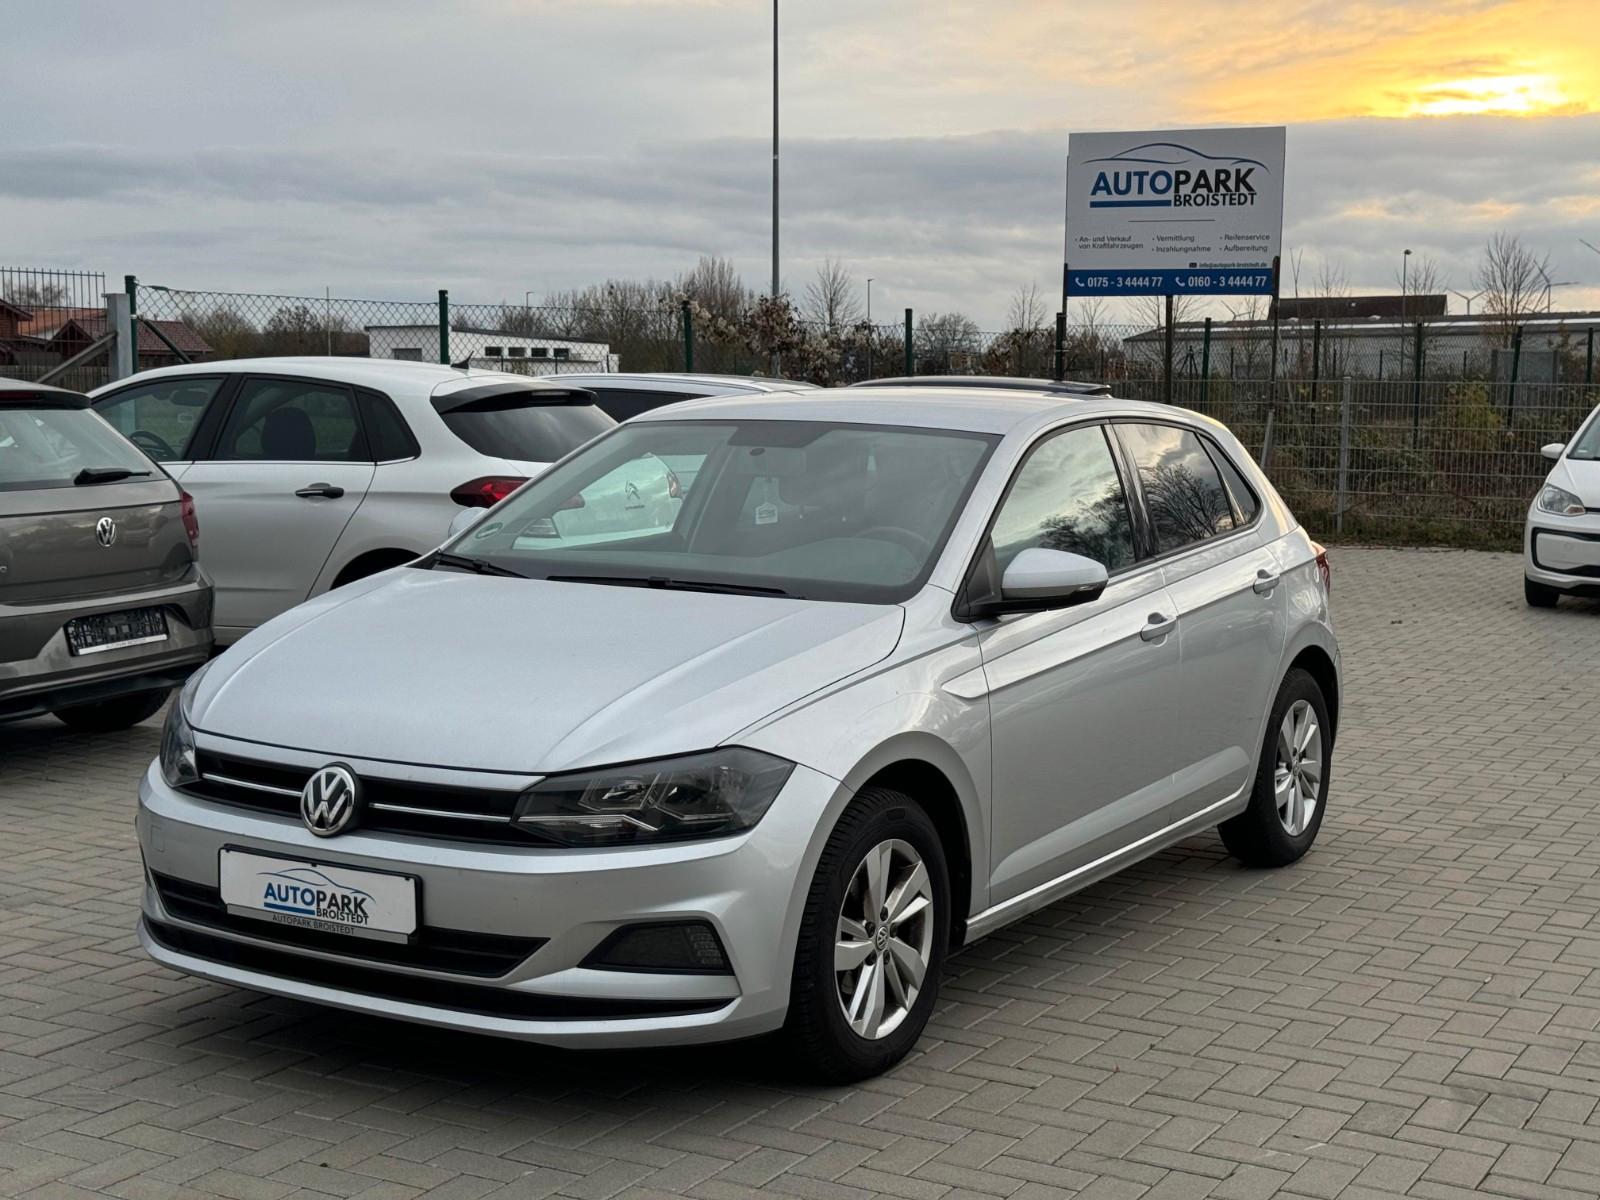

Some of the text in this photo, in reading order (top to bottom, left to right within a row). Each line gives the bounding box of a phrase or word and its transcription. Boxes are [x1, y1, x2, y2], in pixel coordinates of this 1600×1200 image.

[1090, 167, 1256, 196] AUTOPARK
[1173, 192, 1257, 208] BROISTEDT
[1156, 235, 1195, 243] Vermittlung
[1224, 233, 1271, 241] Reifenservice
[1156, 246, 1212, 254] Inzahlungnahme
[1224, 244, 1268, 252] Aufbereitung
[1087, 276, 1109, 287] 0175
[1188, 276, 1211, 287] 0160
[301, 766, 355, 836] VW
[263, 882, 369, 916] AUTOPARK
[316, 907, 369, 926] BROISTEDT
[272, 913, 356, 936] AUTOPARK BROISTEDT
